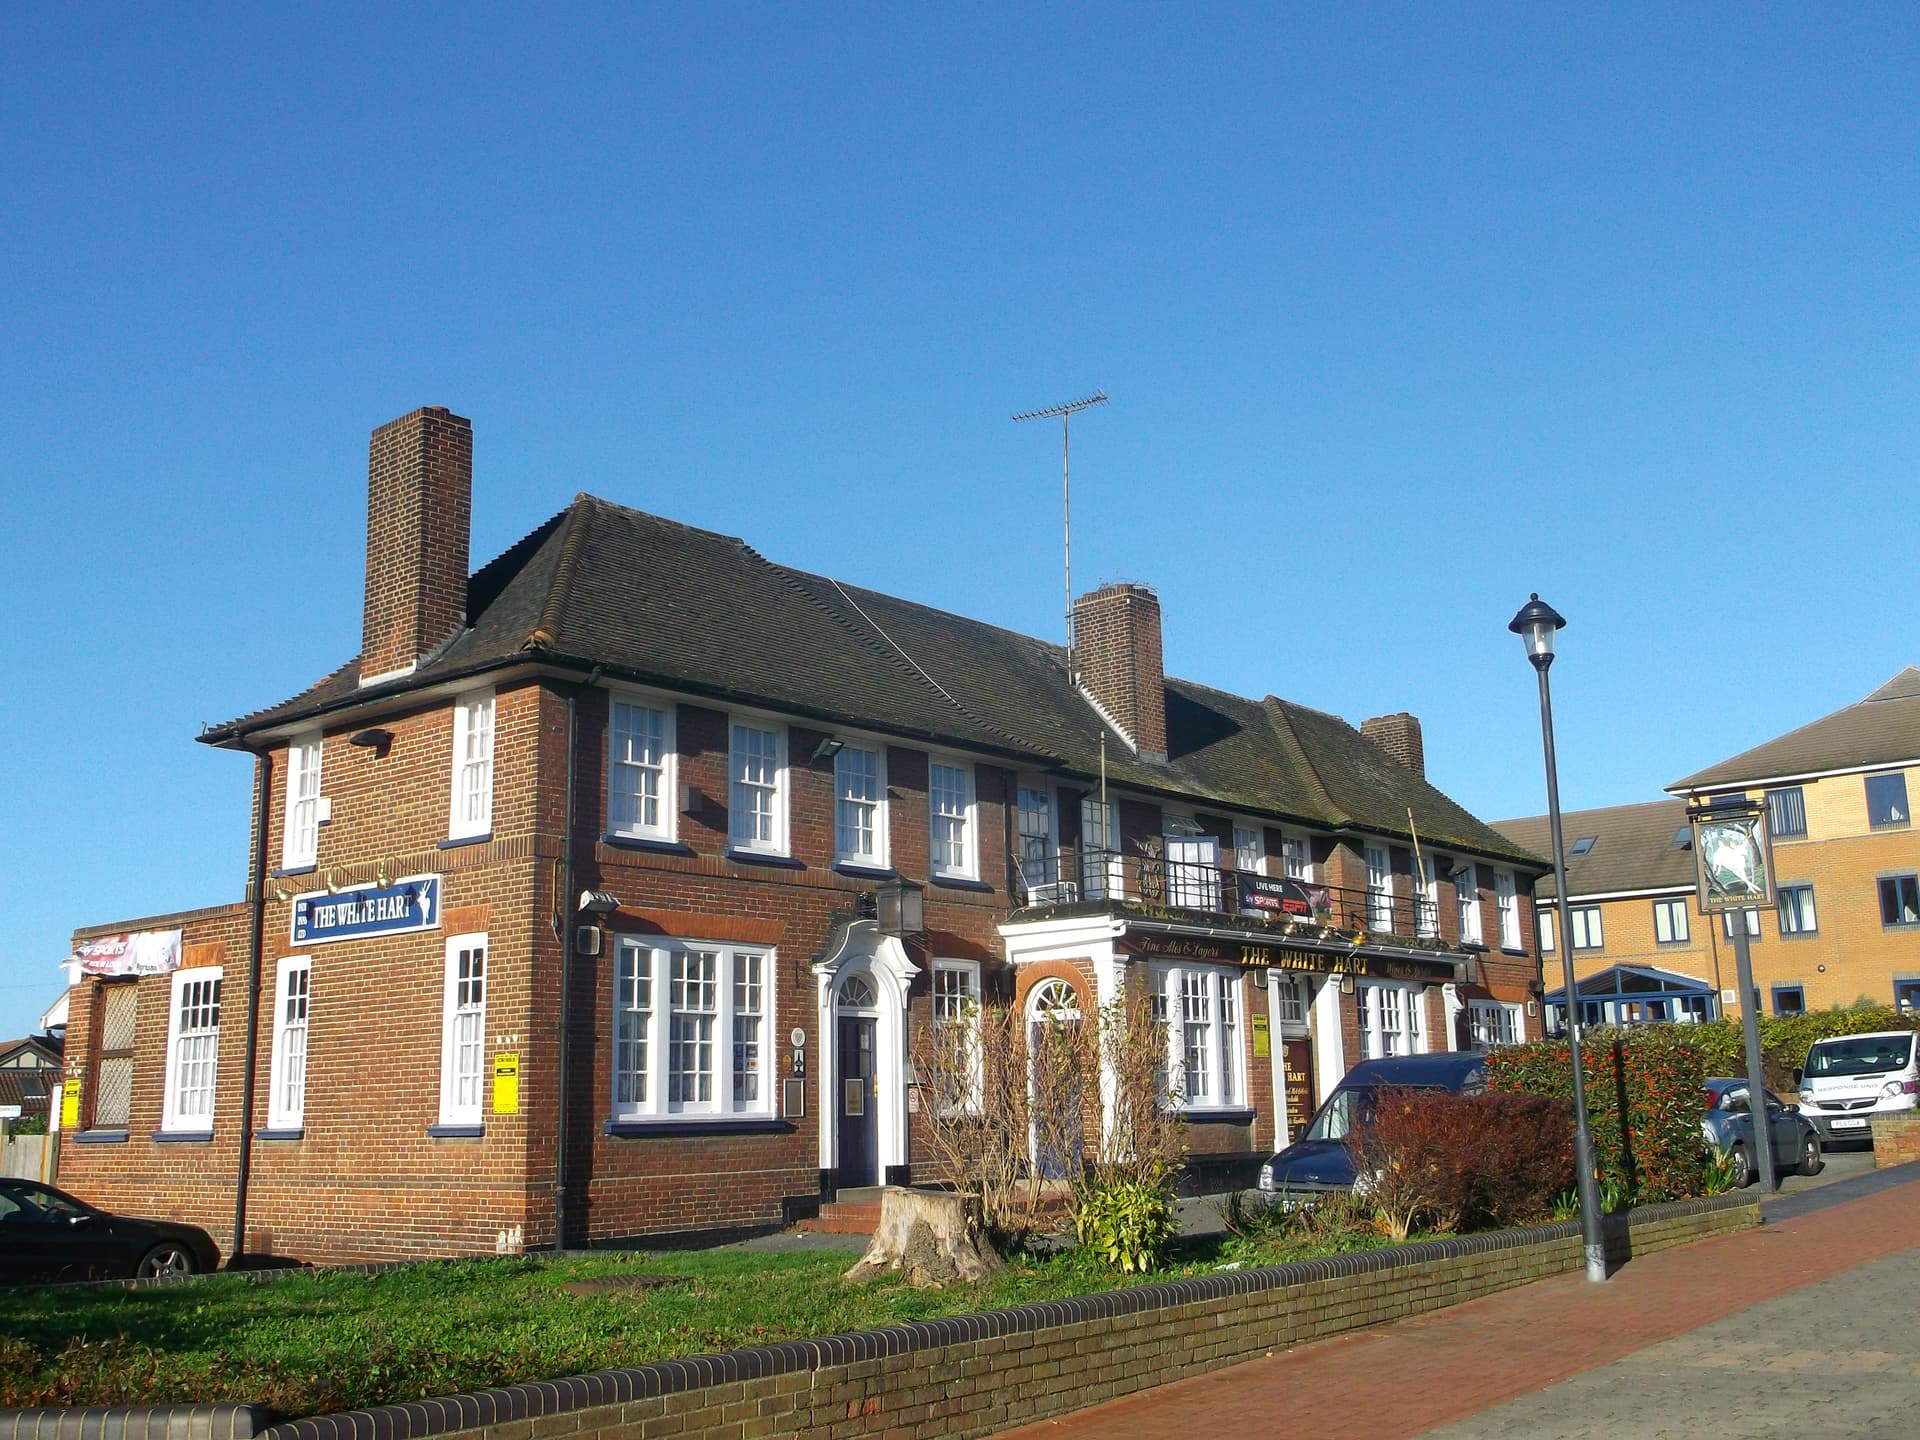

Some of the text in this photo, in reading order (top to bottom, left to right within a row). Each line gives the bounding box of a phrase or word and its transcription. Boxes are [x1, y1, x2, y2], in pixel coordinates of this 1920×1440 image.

[1256, 882, 1283, 893] LIVE HERE
[1254, 896, 1279, 907] SPORTS
[1282, 898, 1307, 913] ESPN
[314, 895, 413, 929] THE WHITE HART
[93, 943, 126, 956] SPORTS
[1140, 936, 1160, 952] Fine
[1182, 942, 1192, 954] &
[1241, 946, 1368, 975] THE WHITE HART
[1283, 1063, 1292, 1071] HE
[1287, 1073, 1305, 1082] HART
[1818, 1084, 1859, 1093] RESPONSE
